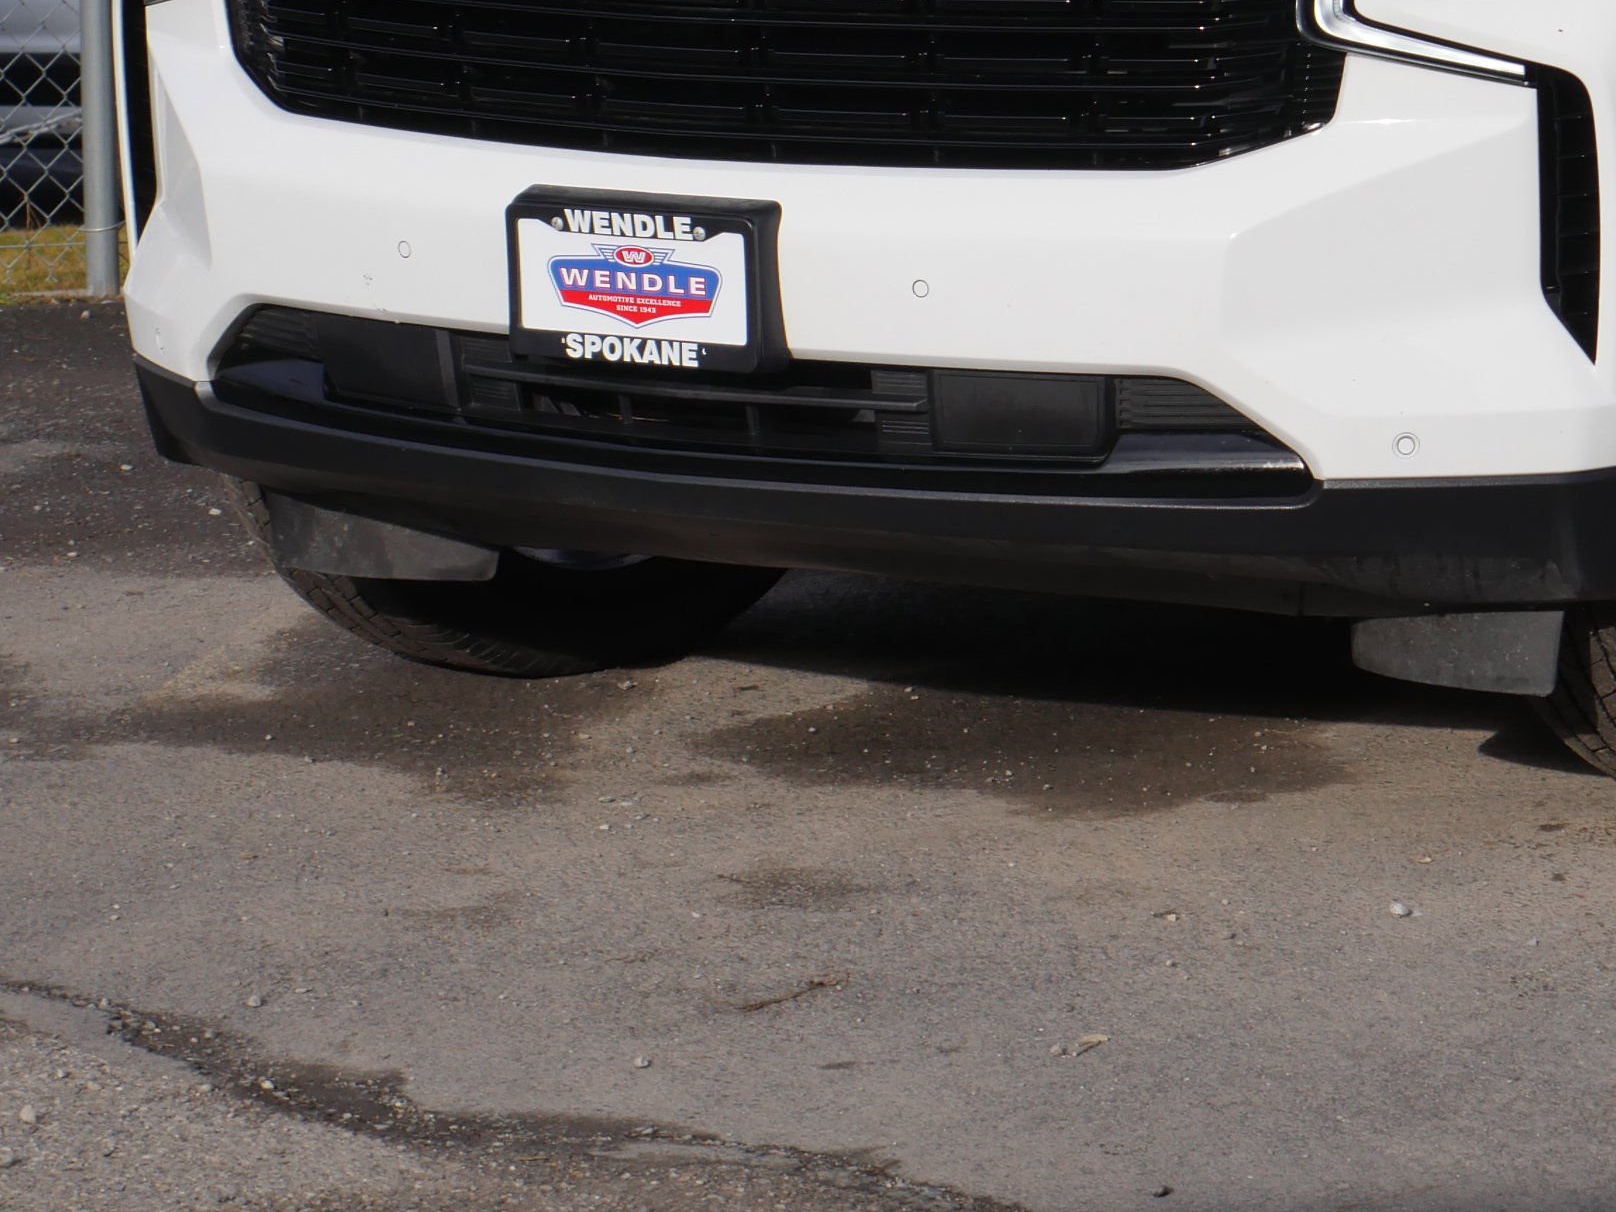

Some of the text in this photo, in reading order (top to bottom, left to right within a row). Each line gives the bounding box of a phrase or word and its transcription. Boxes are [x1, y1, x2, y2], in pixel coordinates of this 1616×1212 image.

[563, 208, 694, 241] WENDLE
[559, 267, 707, 296] WENDLE
[588, 294, 682, 307] AUTOMOTIVE EXCELLENCE
[616, 305, 638, 313] SINCE
[565, 333, 699, 368] SPOKANE
